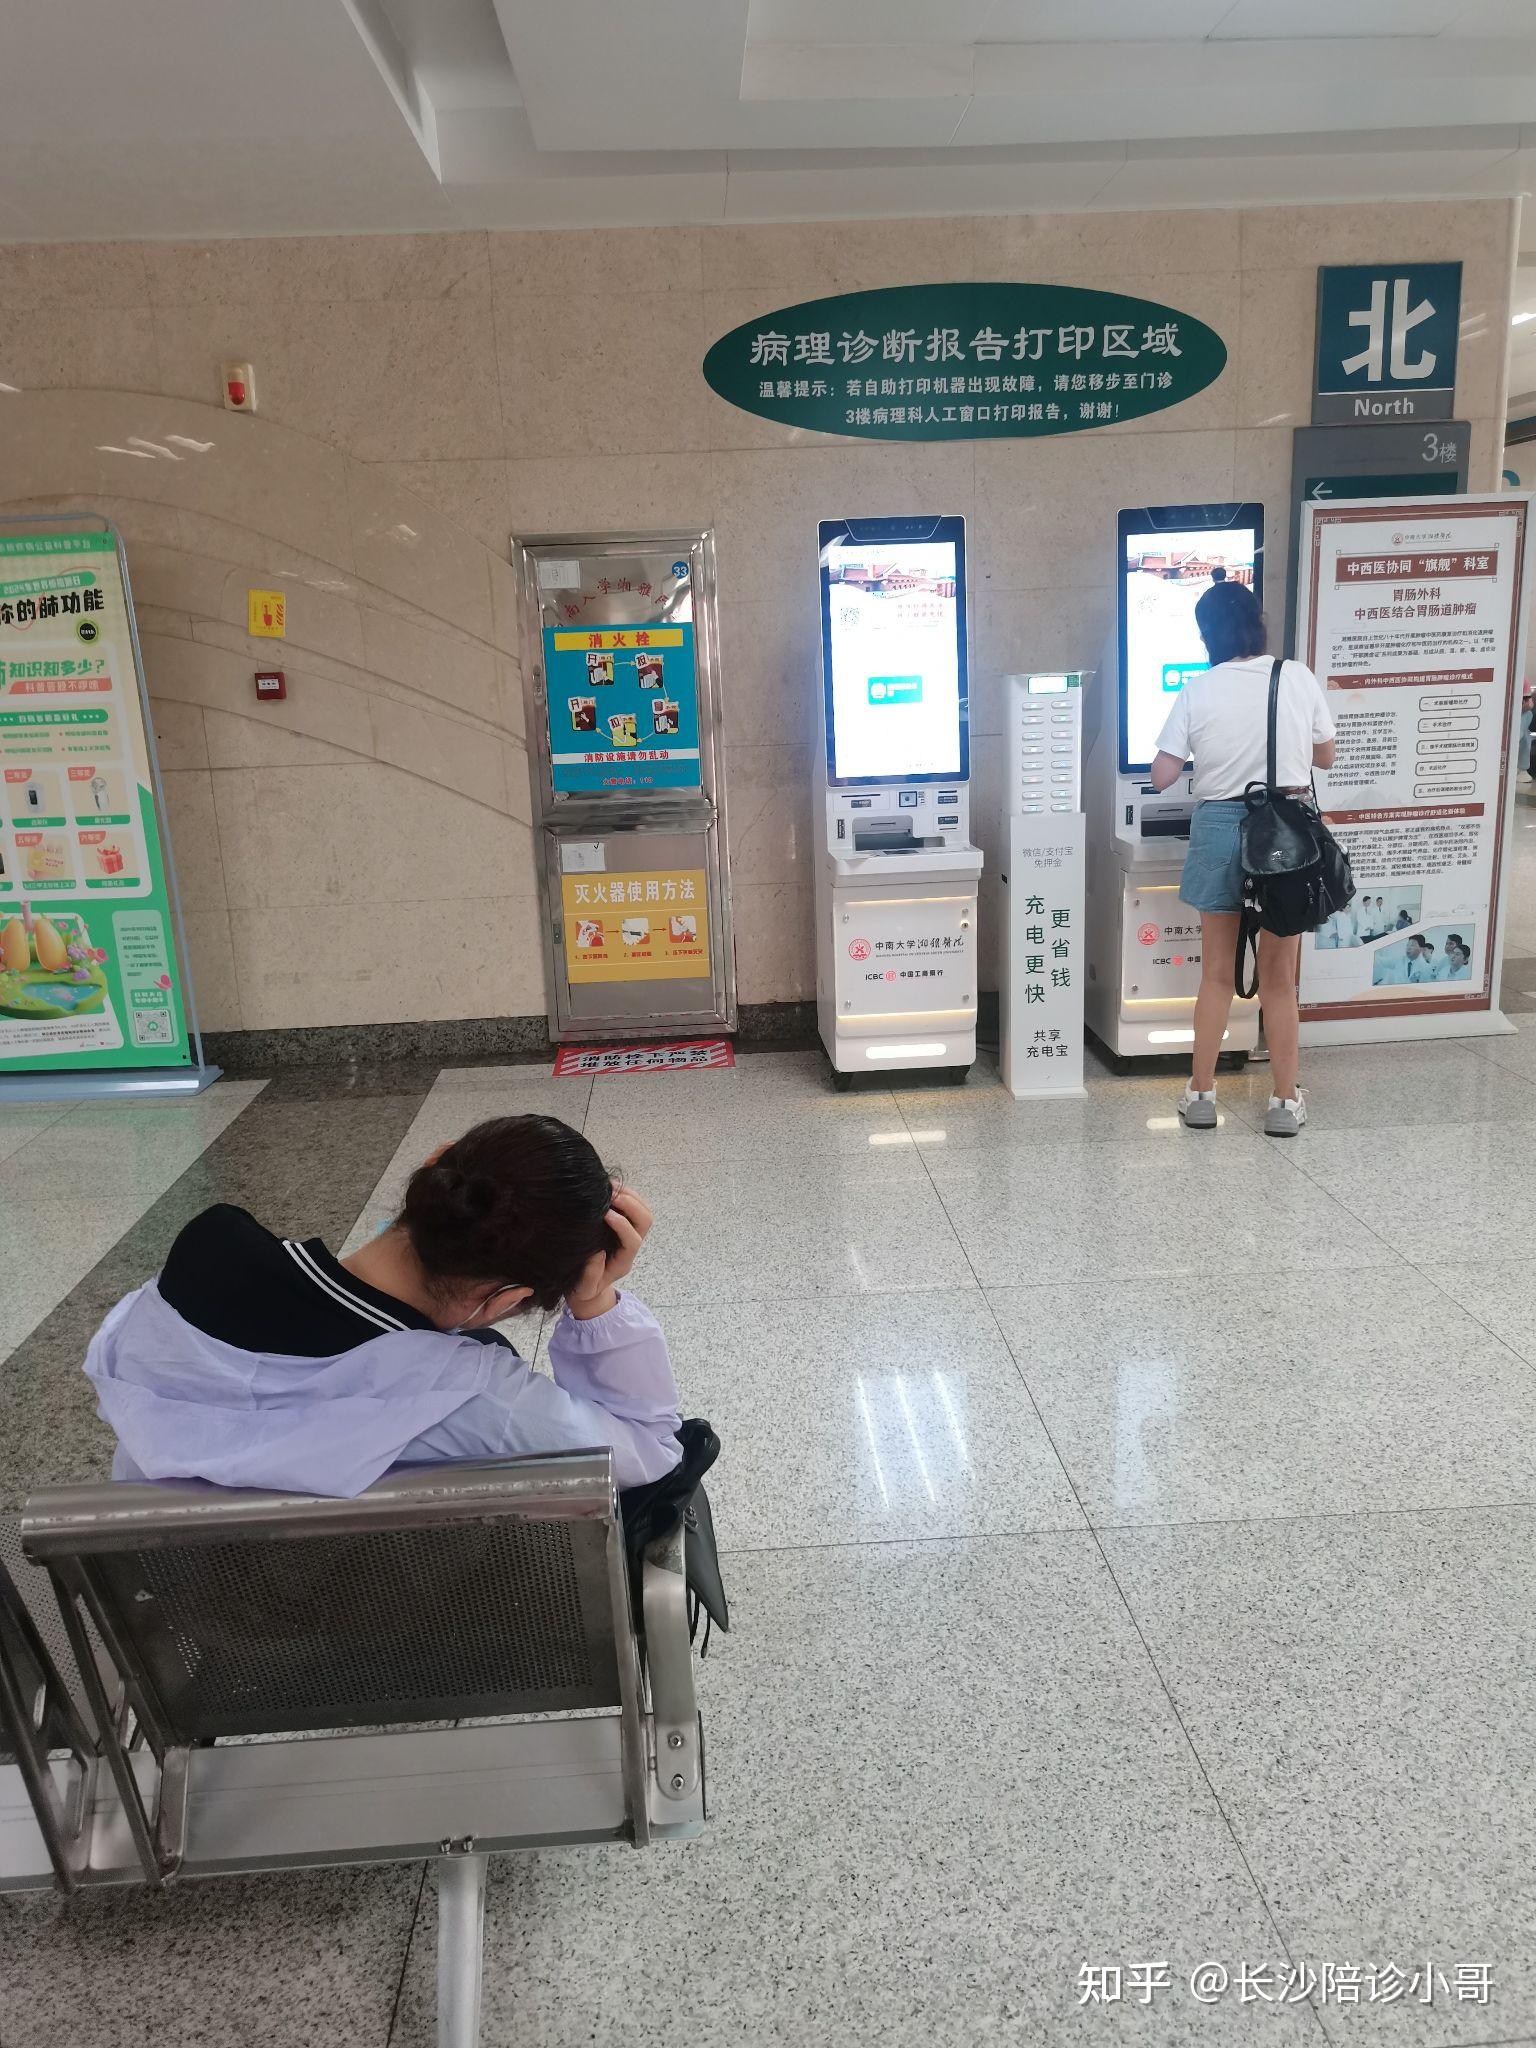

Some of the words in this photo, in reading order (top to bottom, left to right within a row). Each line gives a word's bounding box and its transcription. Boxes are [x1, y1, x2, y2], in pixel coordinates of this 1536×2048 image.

[1342, 278, 1437, 382] 北
[749, 322, 1184, 367] 病理诊断报告打印区域
[845, 402, 1121, 426] 3楼病理科人工窗口打印报告，谢谢！
[1354, 397, 1415, 417] North
[1421, 433, 1457, 464] 3楼
[673, 565, 688, 577] 33
[1347, 556, 1490, 576] 中西医协同“旗舰”科室
[1392, 586, 1441, 601] 胃肠外科
[1354, 602, 1477, 621] 中西医结合胃肠道肿瘤
[588, 632, 651, 648] 消火栓
[584, 750, 669, 763] 消防设施请勿乱动
[1022, 846, 1074, 858] 微信/支付宝
[574, 878, 696, 905] 灭火器使用方法
[1024, 894, 1045, 1004] 充电更快
[1050, 908, 1071, 988] 更省钱
[1152, 957, 1171, 965] ICBC
[865, 972, 884, 981] ICBC
[899, 969, 944, 979] 中国工商银行
[1033, 1029, 1061, 1043] 共享
[1026, 1044, 1069, 1059] 充电宝
